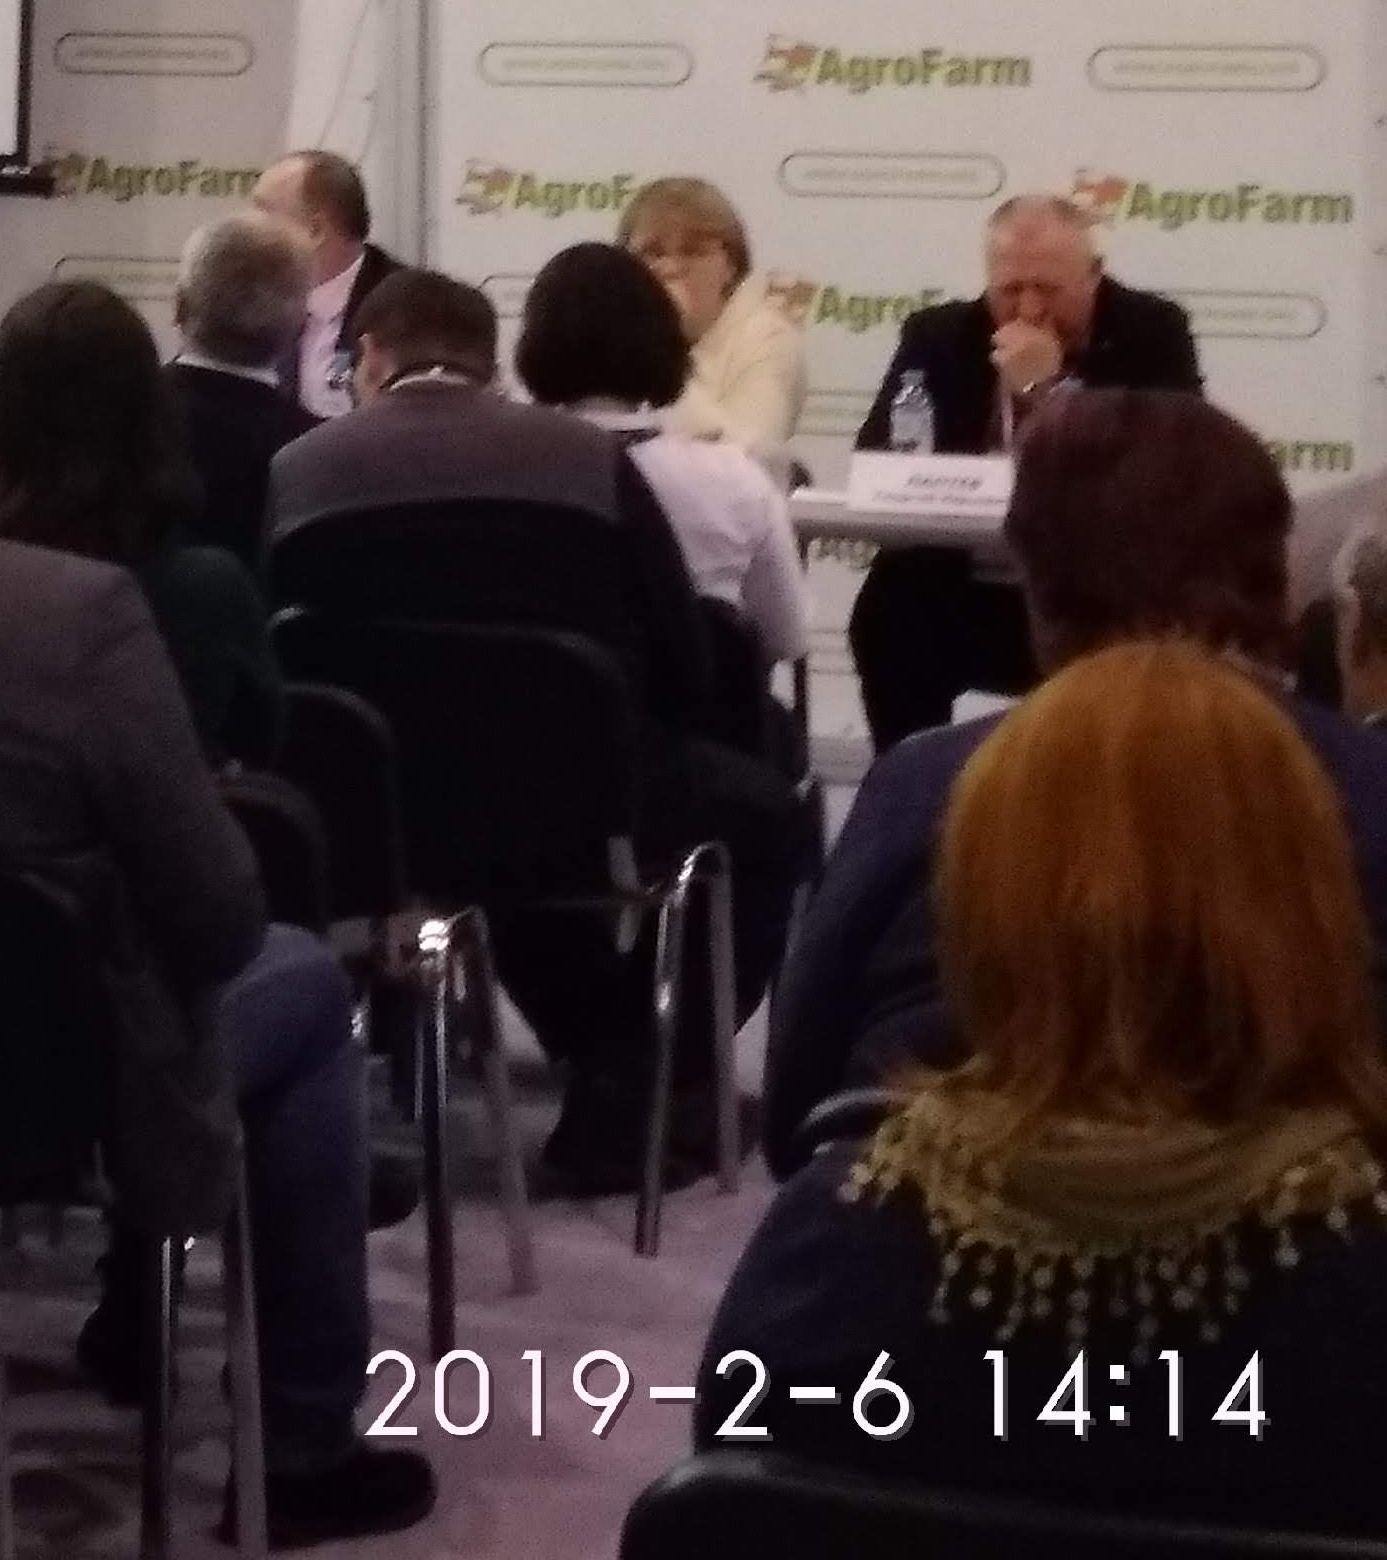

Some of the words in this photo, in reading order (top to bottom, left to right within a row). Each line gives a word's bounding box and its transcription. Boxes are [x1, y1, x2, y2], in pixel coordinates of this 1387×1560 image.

[815, 47, 1030, 93] AgroFarm
[511, 173, 635, 219] AgroF
[1126, 183, 1354, 231] AgroFarm
